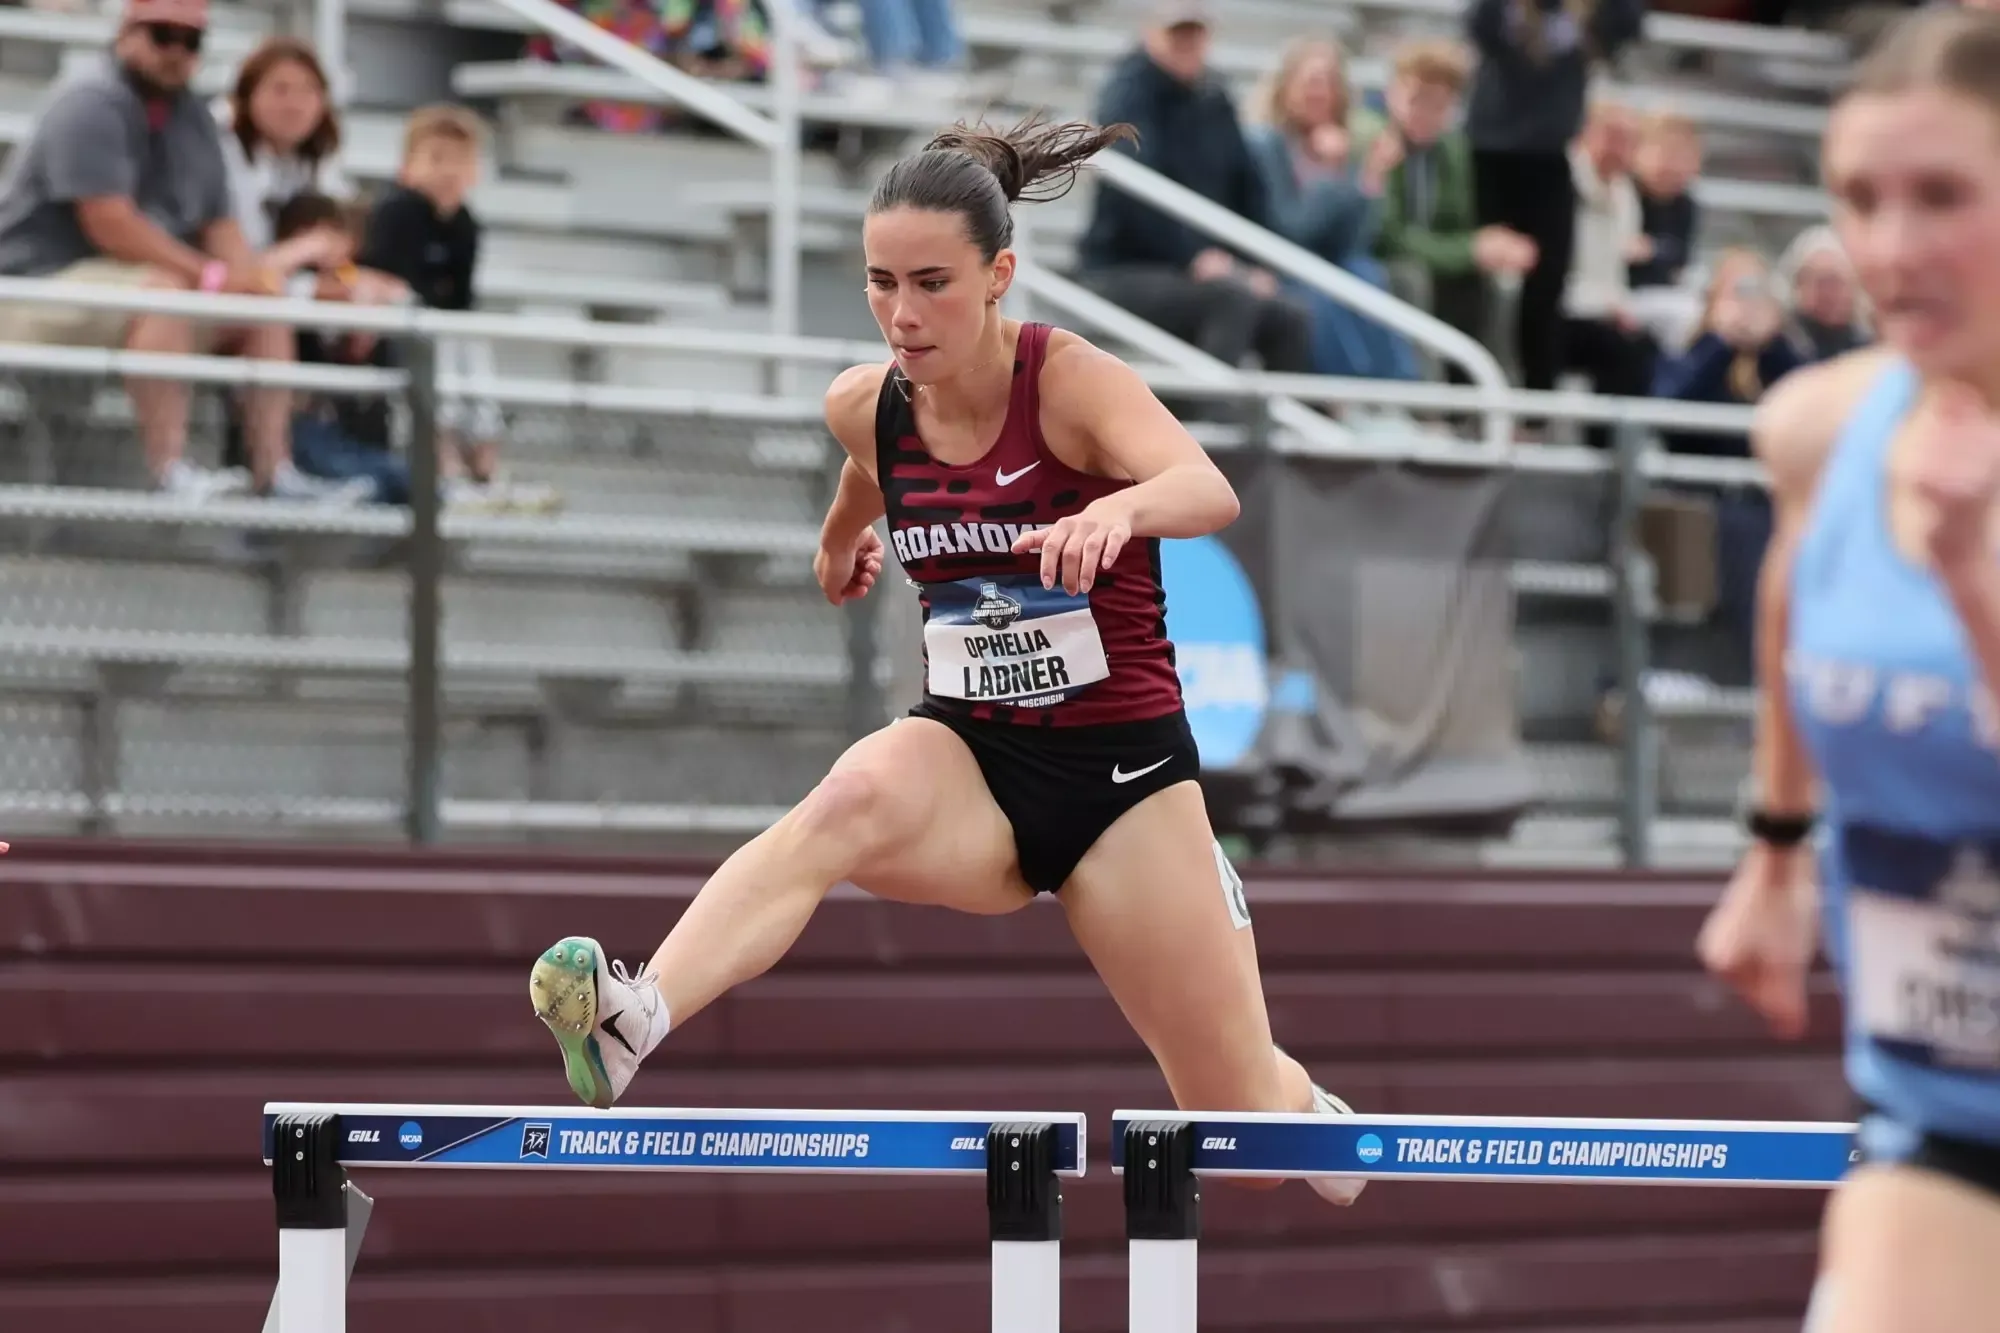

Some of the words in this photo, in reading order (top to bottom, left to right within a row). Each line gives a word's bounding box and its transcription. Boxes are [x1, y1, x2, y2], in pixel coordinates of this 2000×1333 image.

[963, 628, 1052, 660] OPHELIA
[963, 655, 1070, 698] LADNER
[1018, 692, 1065, 708] WISCONSIN
[347, 1130, 380, 1143] GILL
[400, 1134, 423, 1144] NCAA
[559, 1130, 621, 1155] TRACK
[625, 1131, 640, 1155] &
[642, 1131, 697, 1156] FIELD
[700, 1132, 870, 1158] CHAMPIONSHIPS
[950, 1137, 985, 1150] GILL
[1202, 1137, 1237, 1151] GILL
[1359, 1147, 1383, 1157] NCAA
[1396, 1137, 1463, 1163] TRACK
[1466, 1139, 1483, 1164] &
[1485, 1139, 1543, 1165] FIELD
[1547, 1140, 1728, 1169] CHAMPIONSHIPS
